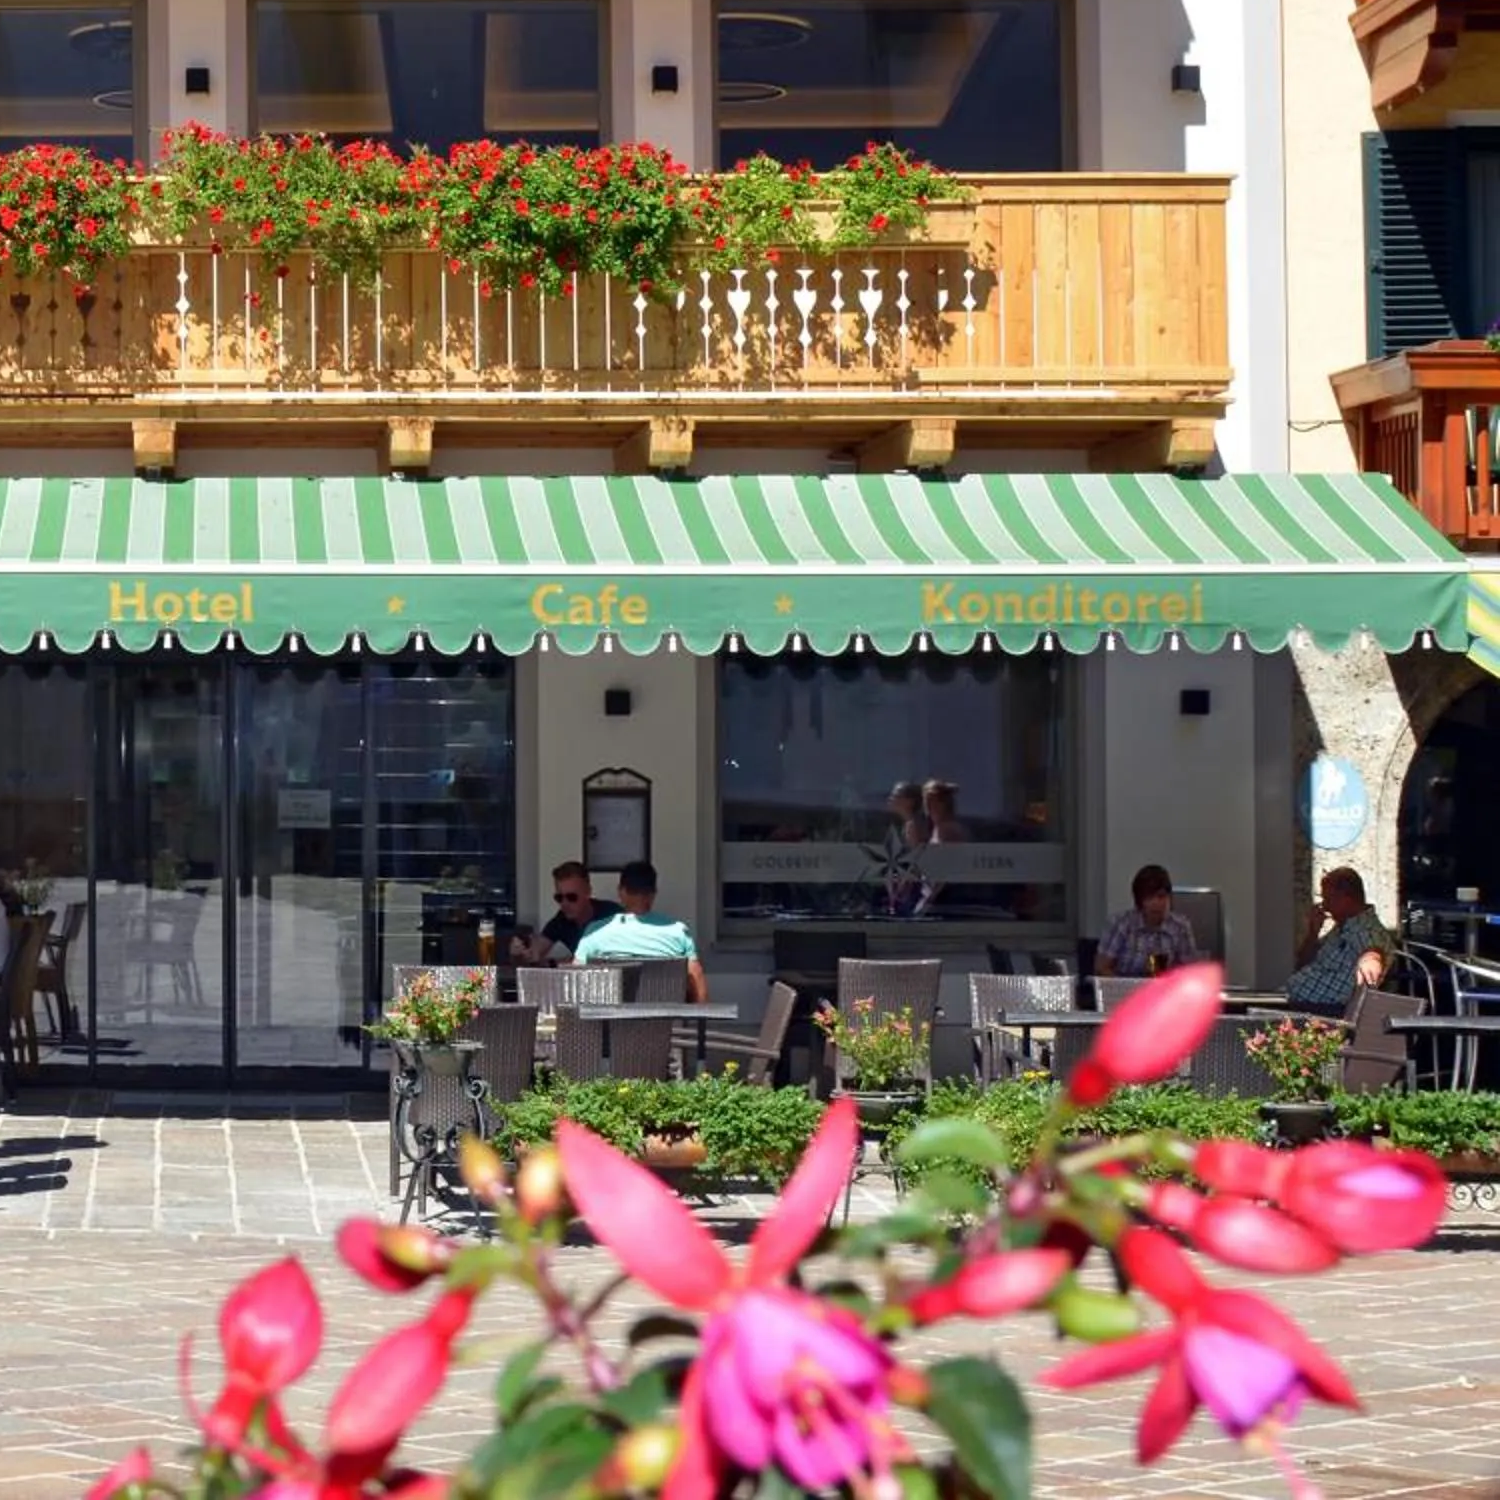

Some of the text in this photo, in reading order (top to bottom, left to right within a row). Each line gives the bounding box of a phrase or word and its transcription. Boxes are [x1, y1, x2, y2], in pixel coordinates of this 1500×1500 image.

[108, 581, 254, 623] Hotel
[530, 582, 649, 625] Cafe
[921, 581, 1204, 624] Konditorei
